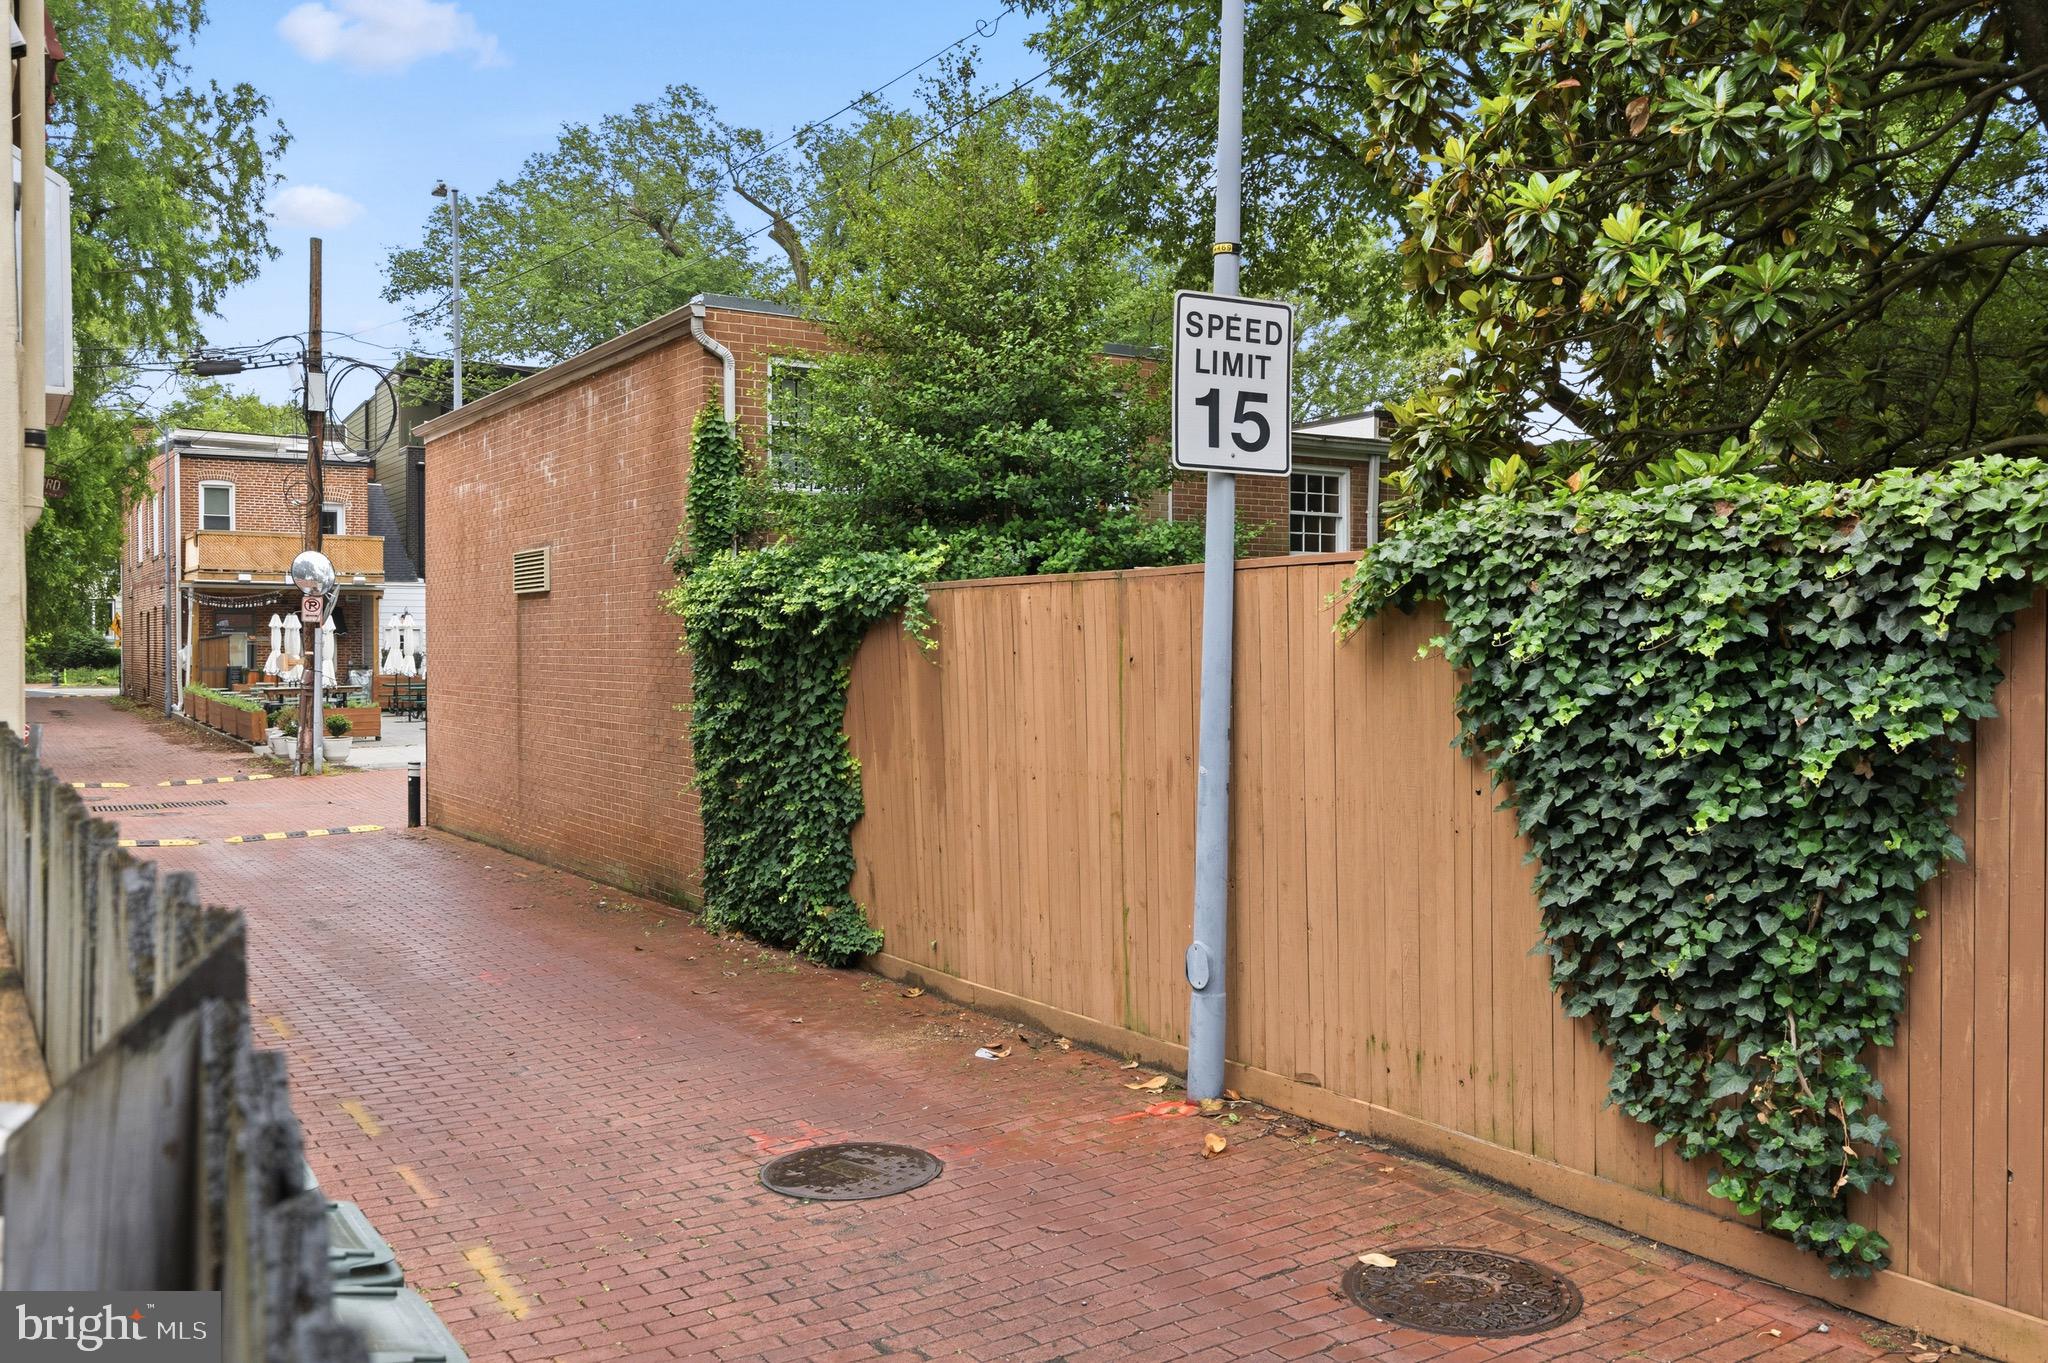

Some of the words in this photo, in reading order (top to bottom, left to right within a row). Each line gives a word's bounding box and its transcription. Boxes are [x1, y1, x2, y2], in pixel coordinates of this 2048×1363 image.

[1186, 311, 1283, 346] SPEED
[1195, 348, 1272, 380] LIMIT
[1195, 388, 1271, 453] 15
[44, 478, 61, 491] RD
